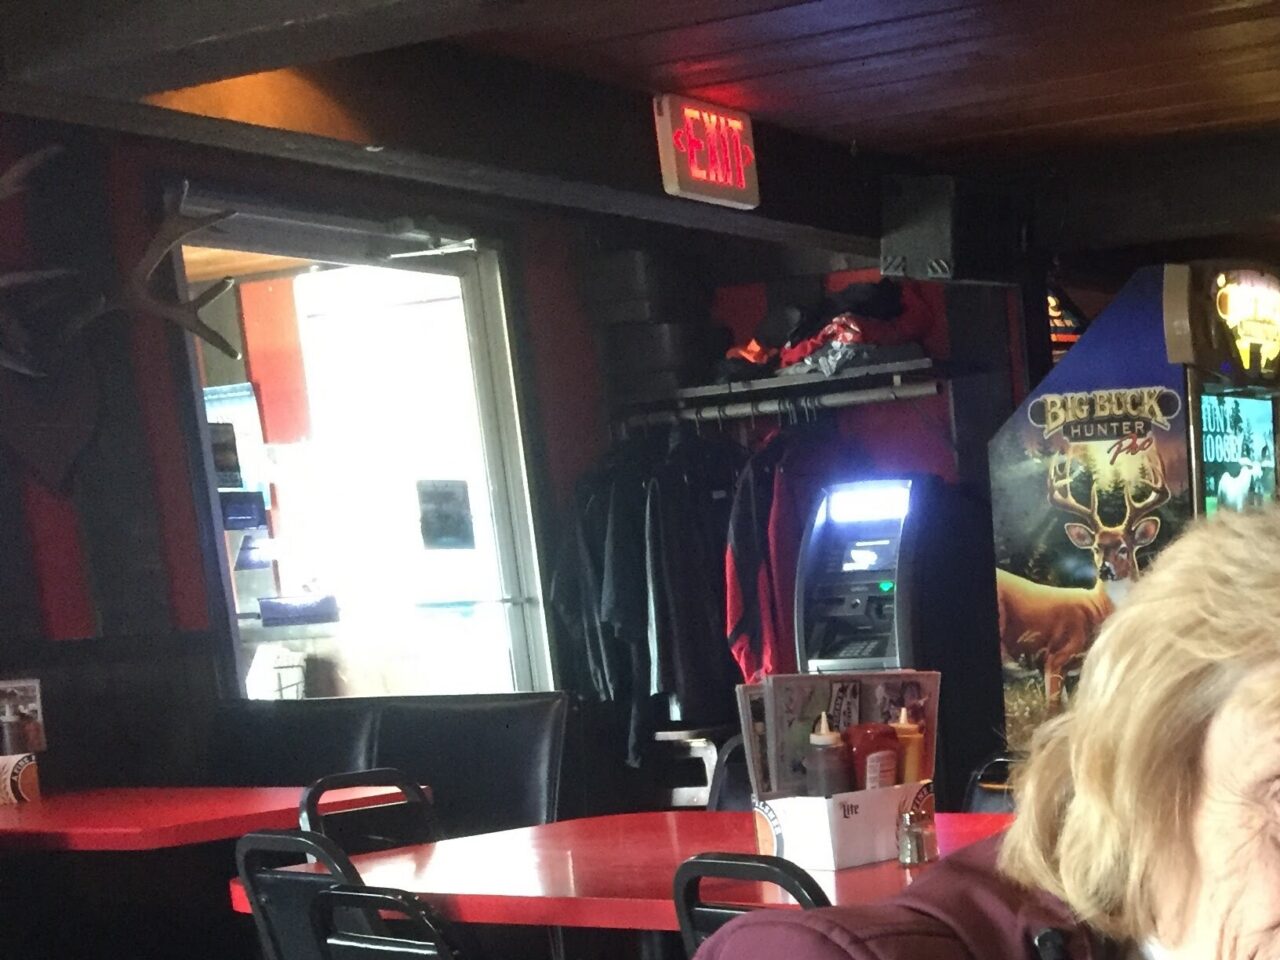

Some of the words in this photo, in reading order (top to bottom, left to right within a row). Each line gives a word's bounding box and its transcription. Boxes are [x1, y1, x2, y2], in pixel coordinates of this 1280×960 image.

[684, 107, 746, 188] EXIT
[1044, 392, 1092, 439] BIG
[1093, 386, 1170, 431] BUCK
[1070, 421, 1146, 438] HUNTER
[838, 800, 860, 819] Lite
